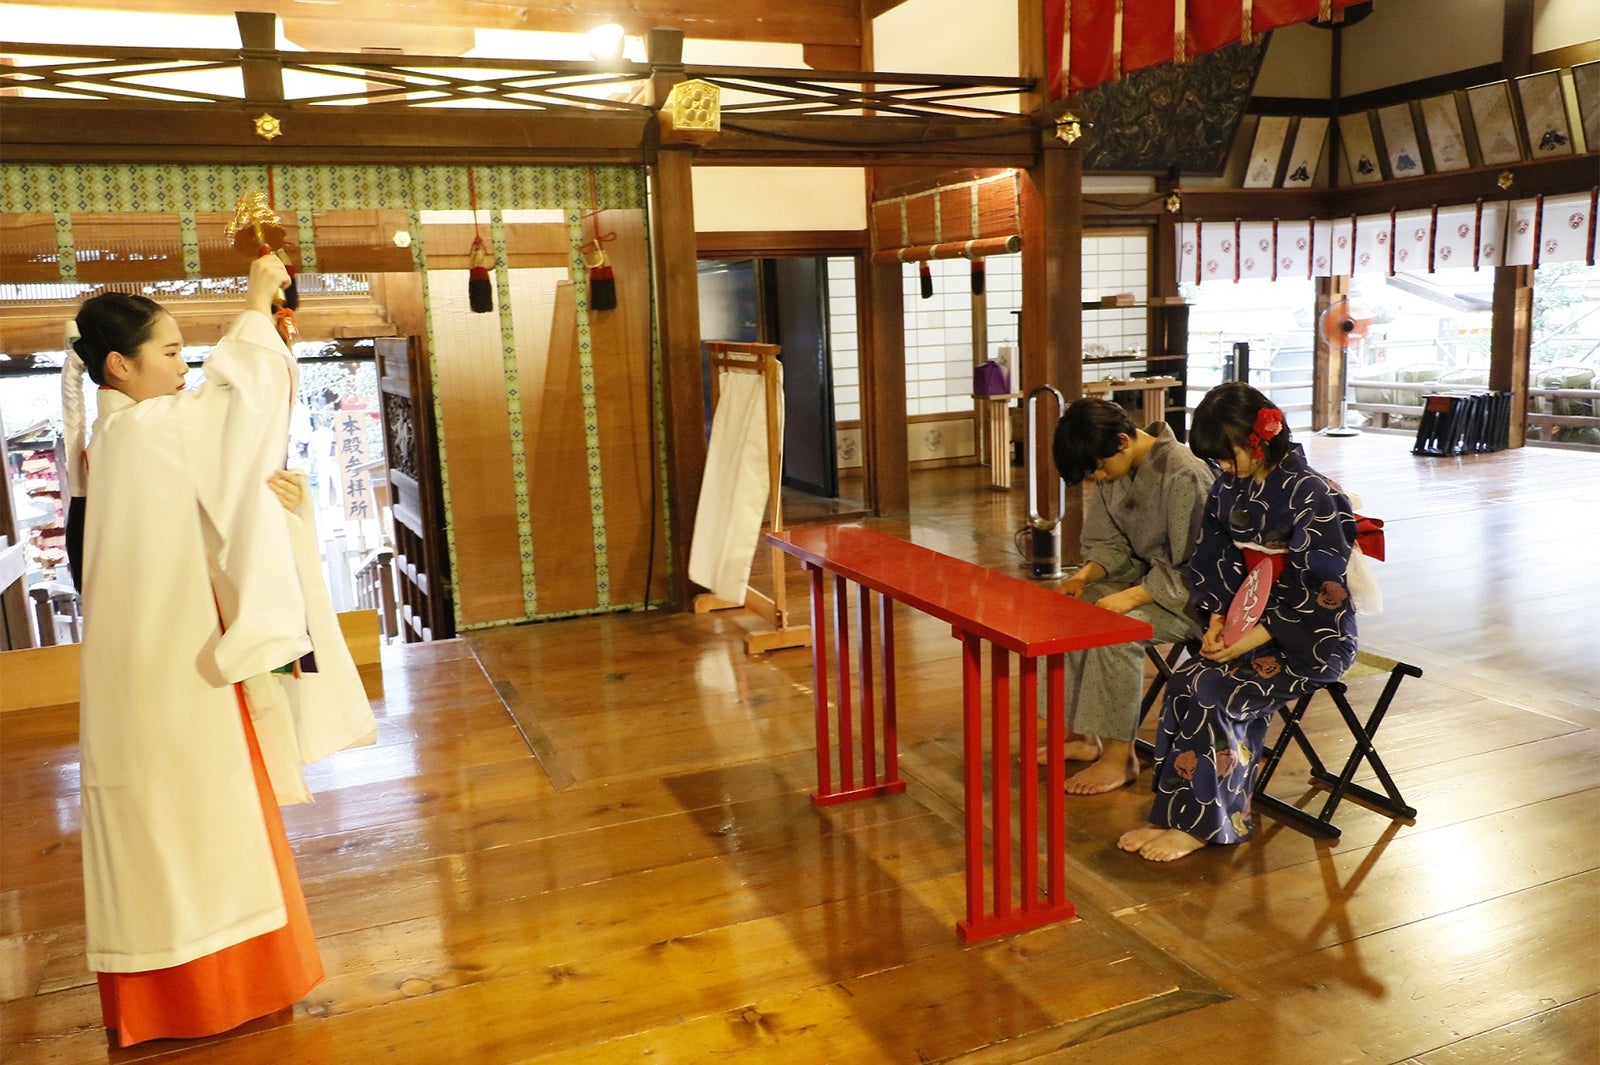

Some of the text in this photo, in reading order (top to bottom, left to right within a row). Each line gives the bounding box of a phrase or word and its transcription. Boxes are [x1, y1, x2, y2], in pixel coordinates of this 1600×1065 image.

[341, 415, 368, 519] 本殿参拝所
